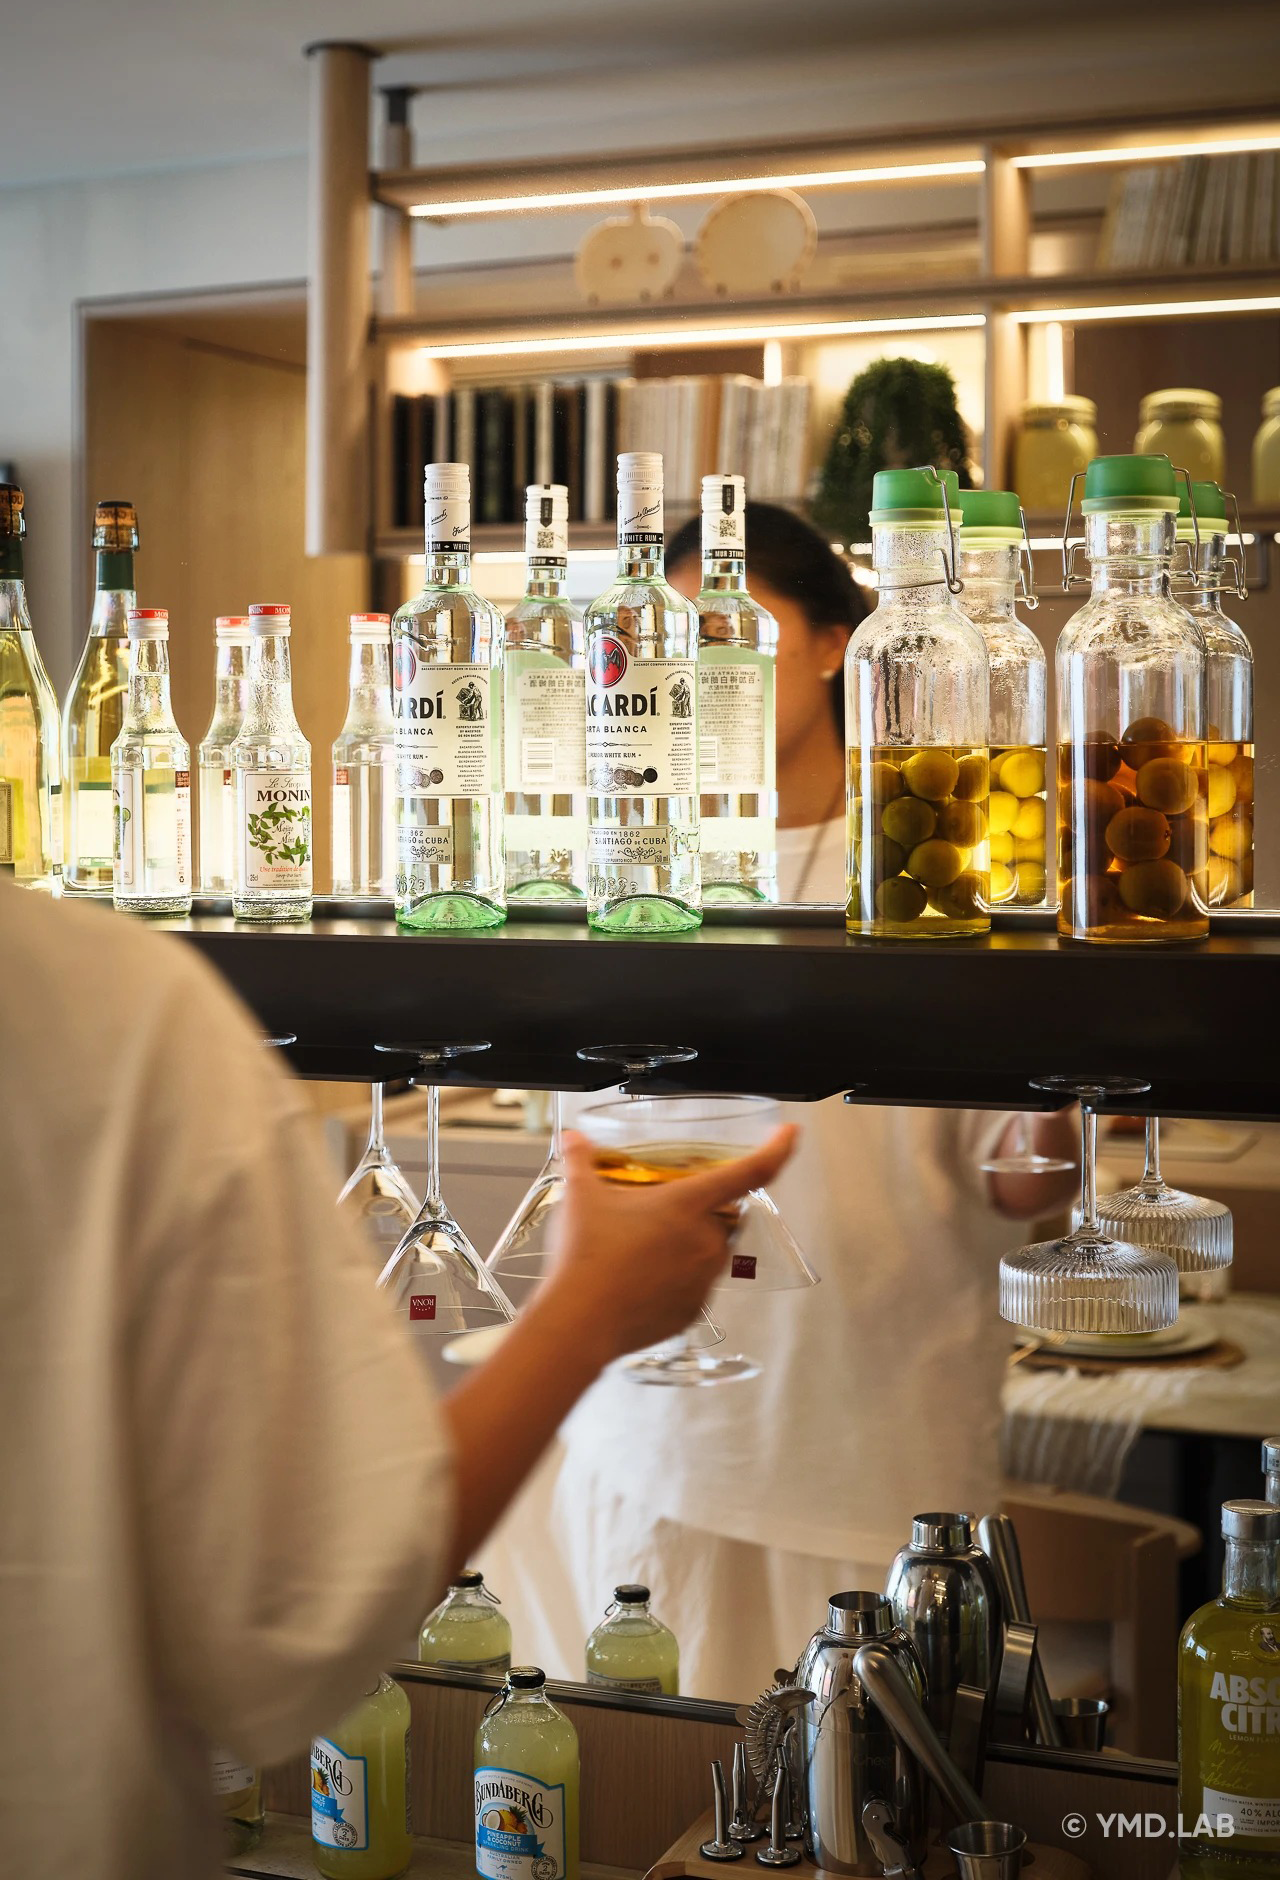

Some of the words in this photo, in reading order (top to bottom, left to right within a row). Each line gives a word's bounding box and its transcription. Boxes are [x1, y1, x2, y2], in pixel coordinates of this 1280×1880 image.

[265, 777, 279, 788] Le
[257, 790, 310, 802] MONIN
[620, 830, 640, 838] 1862
[595, 837, 632, 845] SANTIAGO
[642, 837, 667, 845] CUBA
[1229, 1734, 1254, 1743] LEMON
[475, 1780, 554, 1829] BUNDABERG
[1240, 1808, 1262, 1818] 40%
[487, 1831, 521, 1841] PINEAPPLE
[491, 1837, 521, 1847] COCONUT
